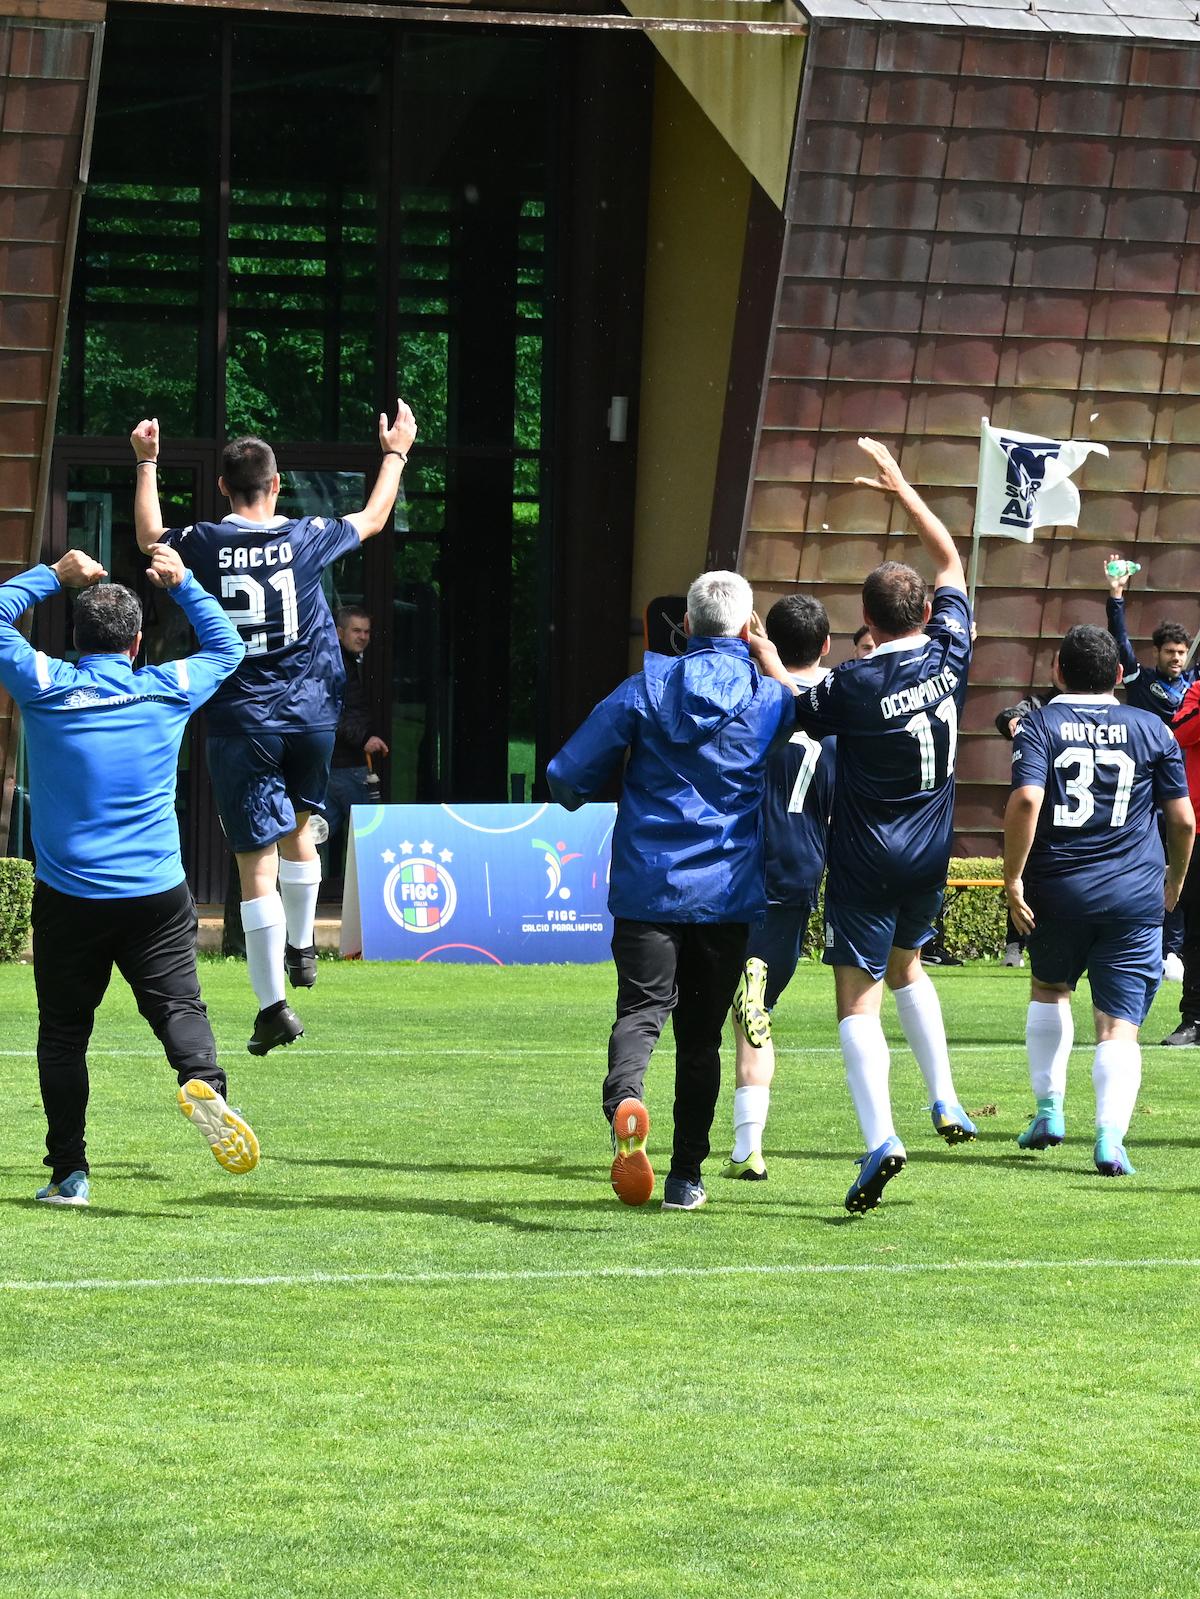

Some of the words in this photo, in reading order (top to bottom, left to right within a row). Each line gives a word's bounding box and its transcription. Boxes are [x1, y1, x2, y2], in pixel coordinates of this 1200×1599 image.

[219, 542, 293, 569] SACCO
[221, 568, 299, 656] 21
[880, 672, 950, 720] OCCHIPINTI
[905, 695, 958, 791] 11
[1060, 722, 1128, 744] AUTERI
[1053, 747, 1136, 827] 37
[401, 883, 439, 901] FIGC
[522, 924, 550, 932] CALCIO
[552, 923, 603, 932] PARALIMPICO
[547, 910, 577, 921] FIGC
